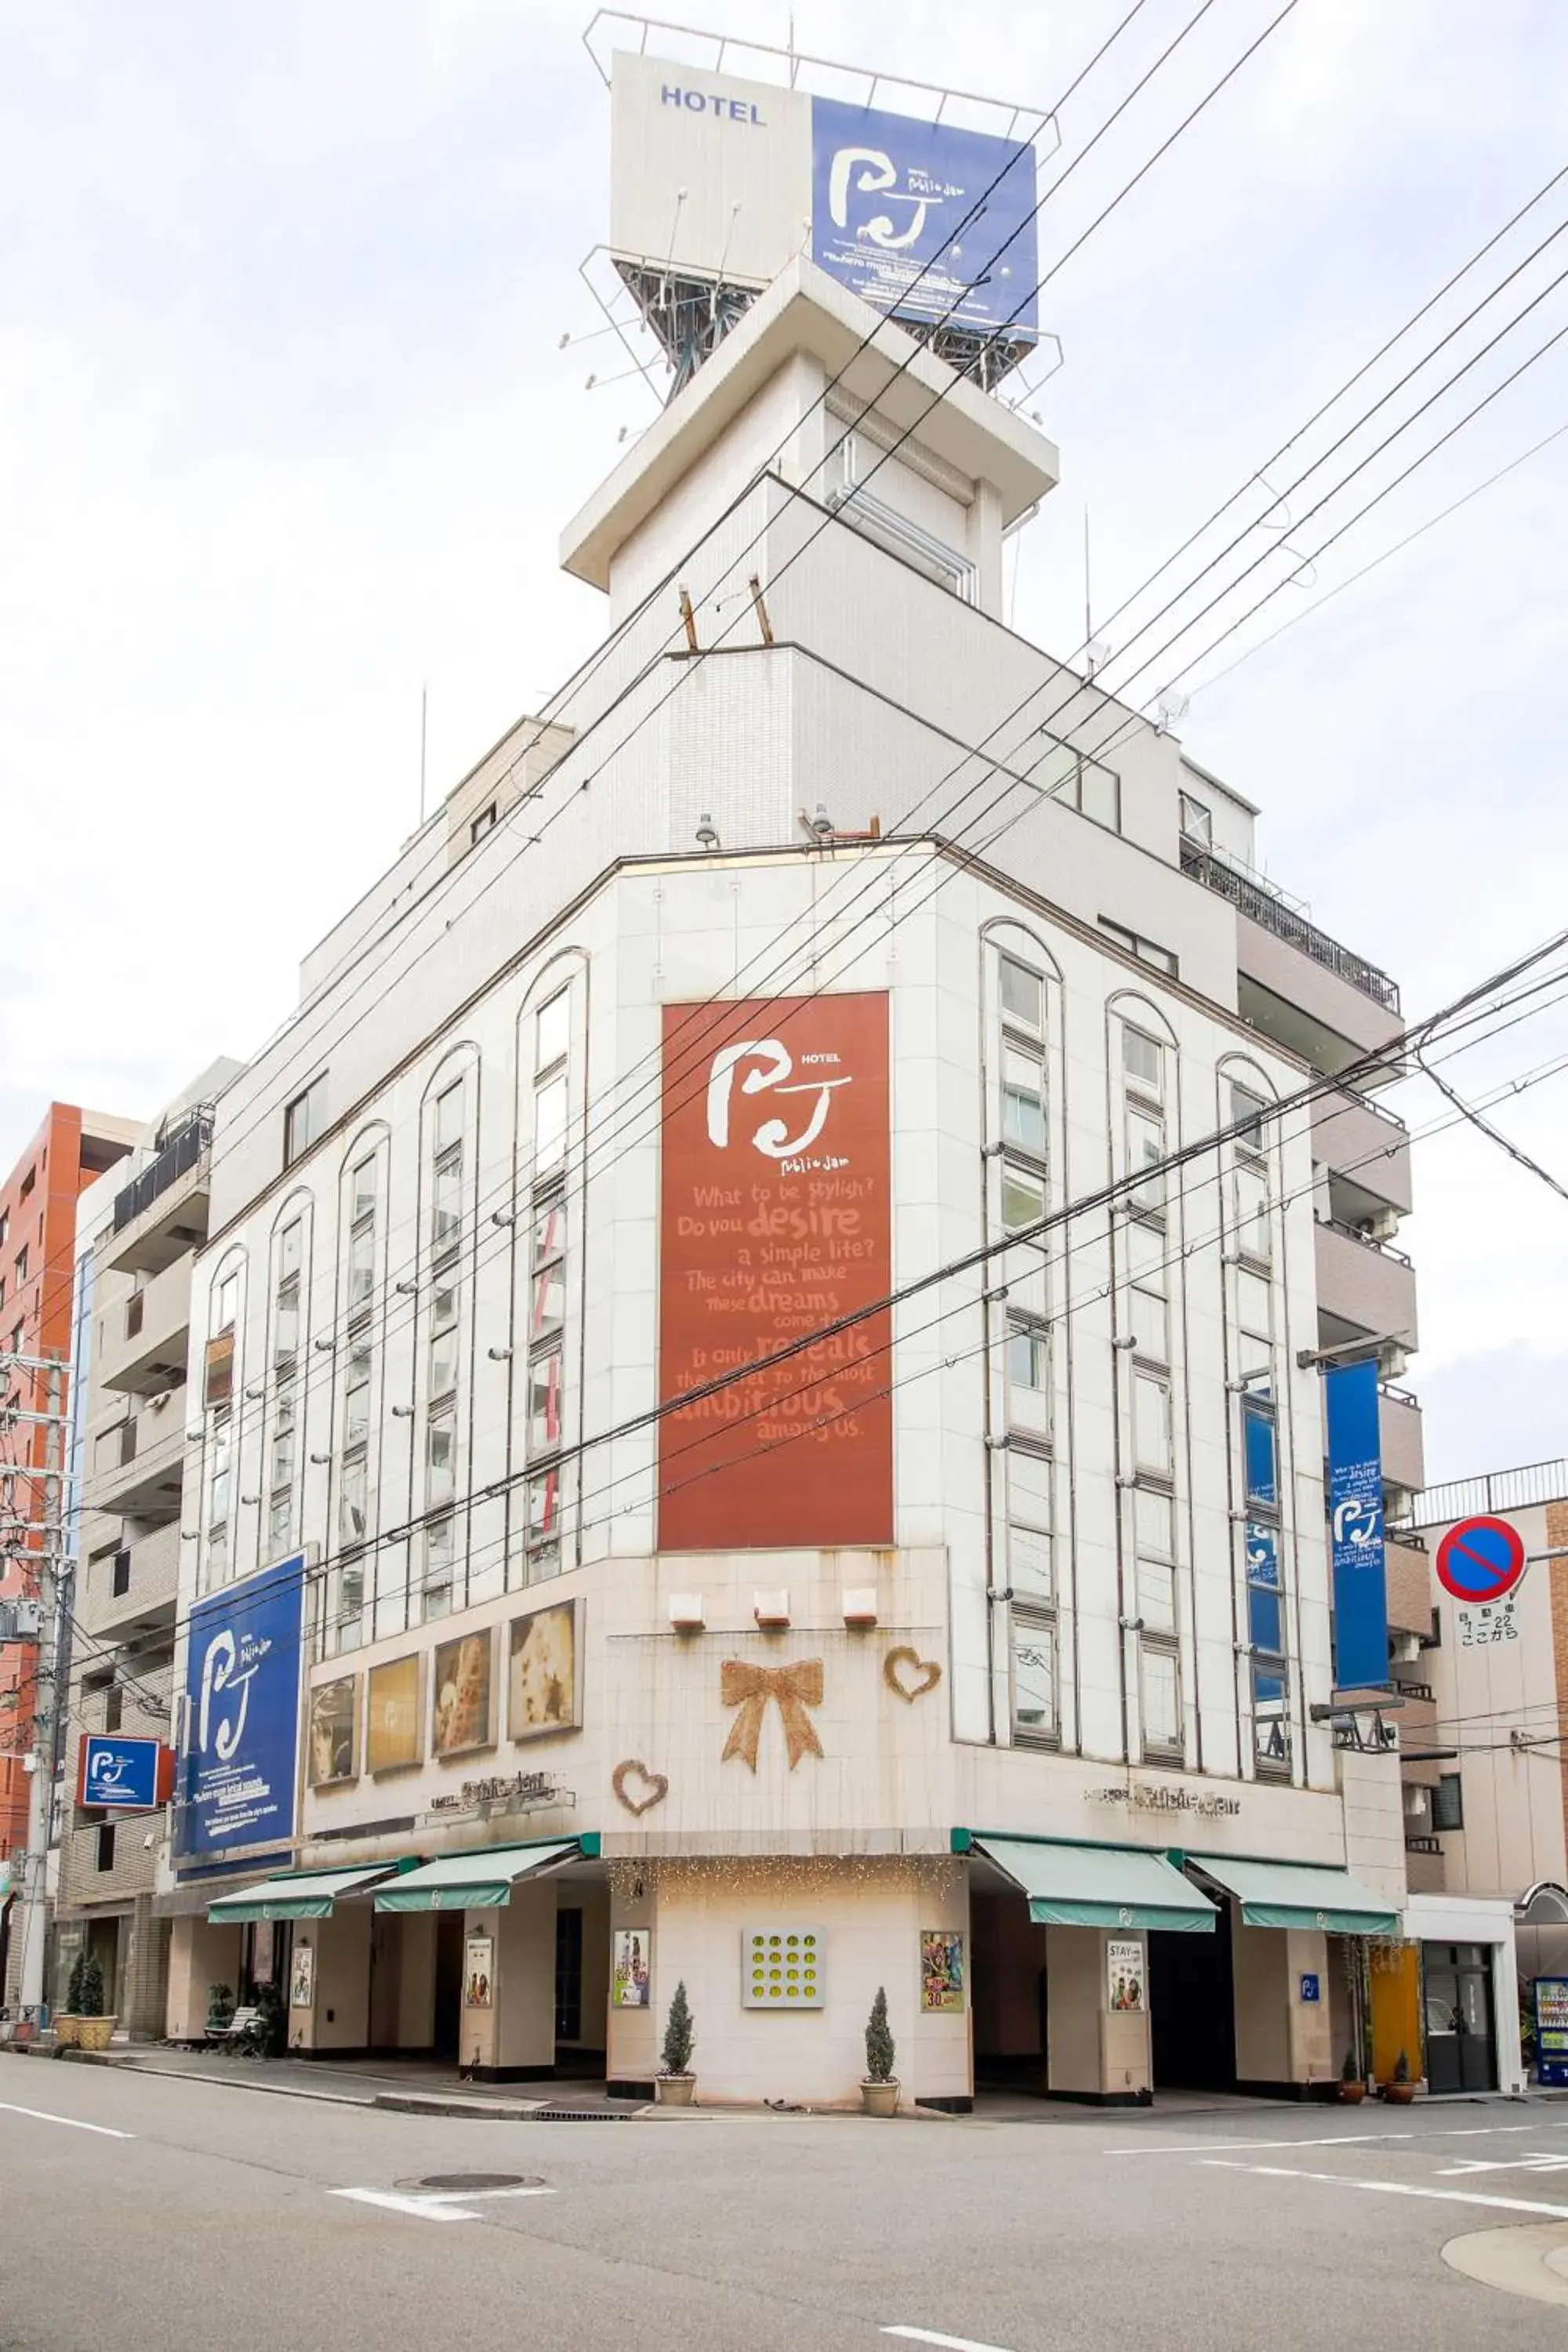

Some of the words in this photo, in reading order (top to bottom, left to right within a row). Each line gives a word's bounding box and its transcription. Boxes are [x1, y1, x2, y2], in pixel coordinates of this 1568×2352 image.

[661, 84, 768, 127] HOTEL
[801, 1053, 841, 1064] HOTEL
[694, 1185, 742, 1207] What
[751, 1182, 771, 1202] to
[779, 1182, 800, 1200] be
[808, 1177, 874, 1201] stylish?
[678, 1217, 705, 1236] Do
[710, 1218, 743, 1236] you
[747, 1202, 861, 1239] desire
[738, 1248, 752, 1265] a
[761, 1242, 821, 1269] simple
[686, 1269, 716, 1291] The
[722, 1269, 756, 1292] city
[762, 1269, 797, 1285] can
[801, 1265, 848, 1282] make
[748, 1284, 840, 1313] dreams
[773, 1315, 815, 1328] come
[1462, 1627, 1518, 1646] ここから
[1109, 1945, 1131, 1957] STAY
